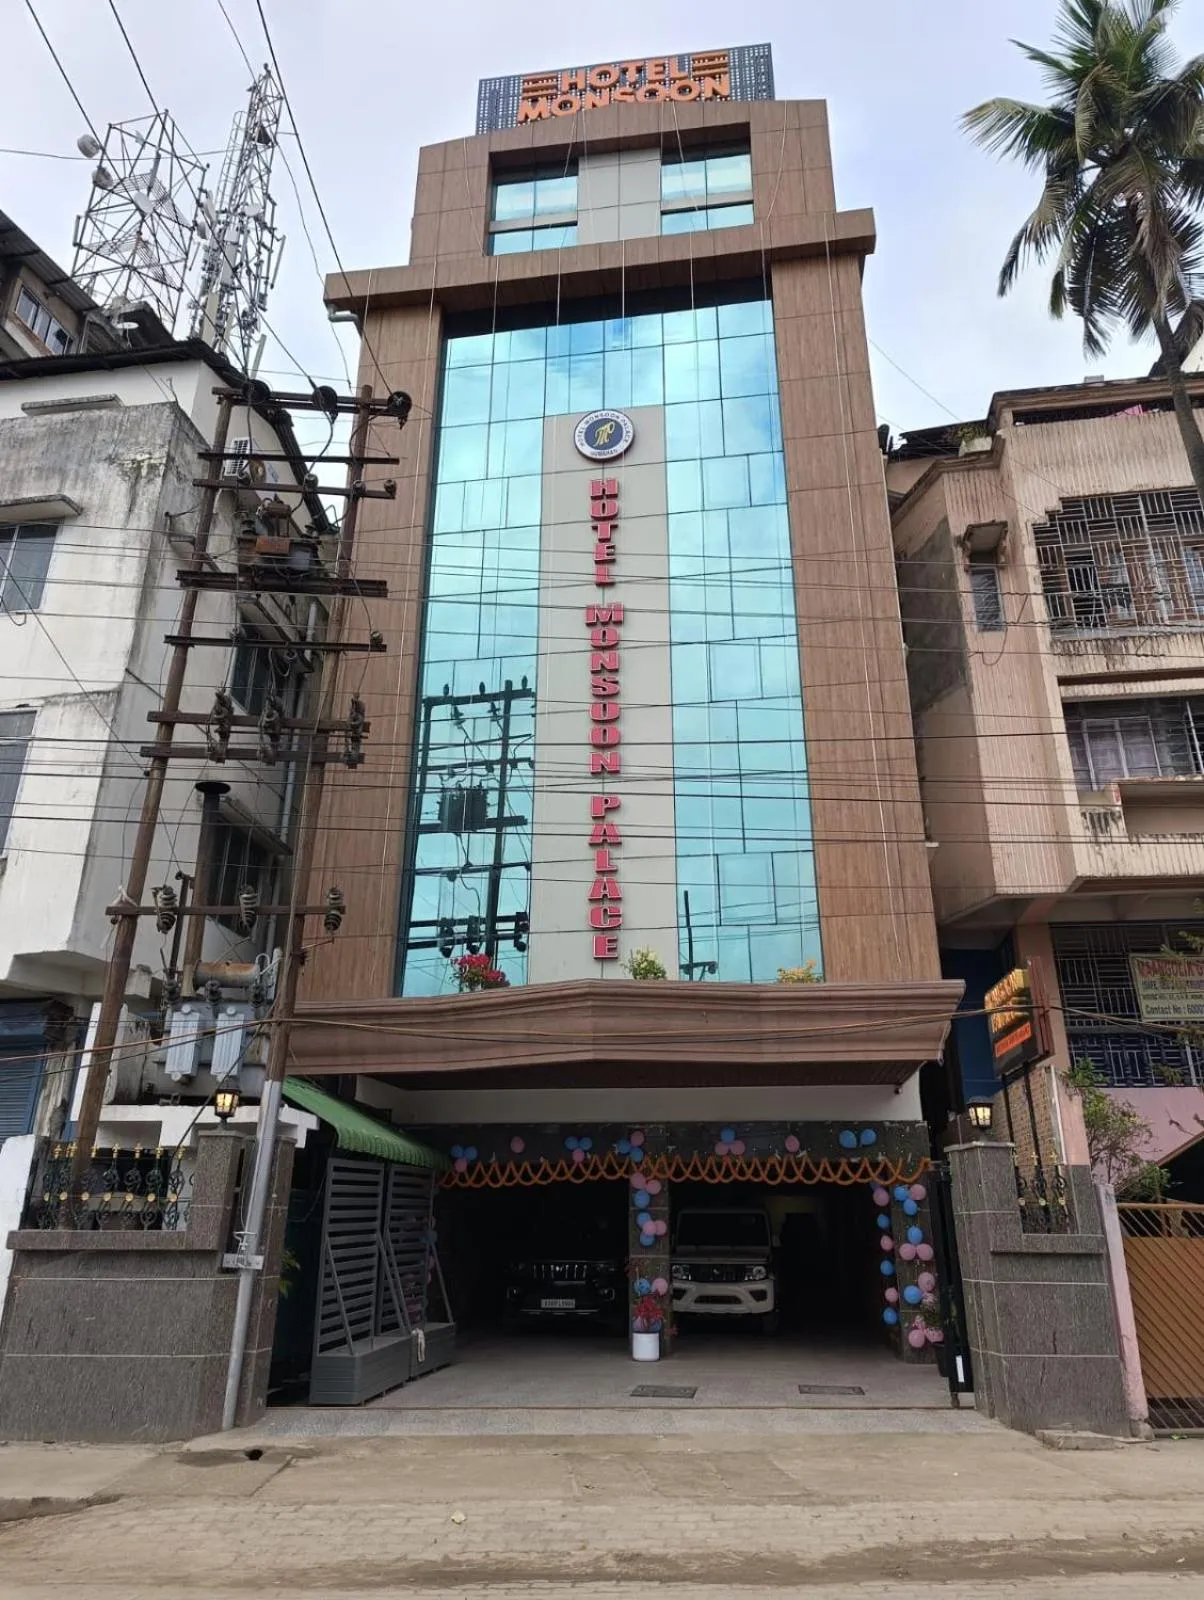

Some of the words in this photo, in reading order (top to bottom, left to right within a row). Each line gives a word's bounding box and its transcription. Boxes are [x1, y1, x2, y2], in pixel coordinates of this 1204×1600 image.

[517, 74, 729, 122] MONSOON
[561, 56, 688, 93] HOTEL
[589, 478, 619, 587] HOTEL
[584, 601, 624, 775] MONSOON
[588, 795, 623, 960] PALACE
